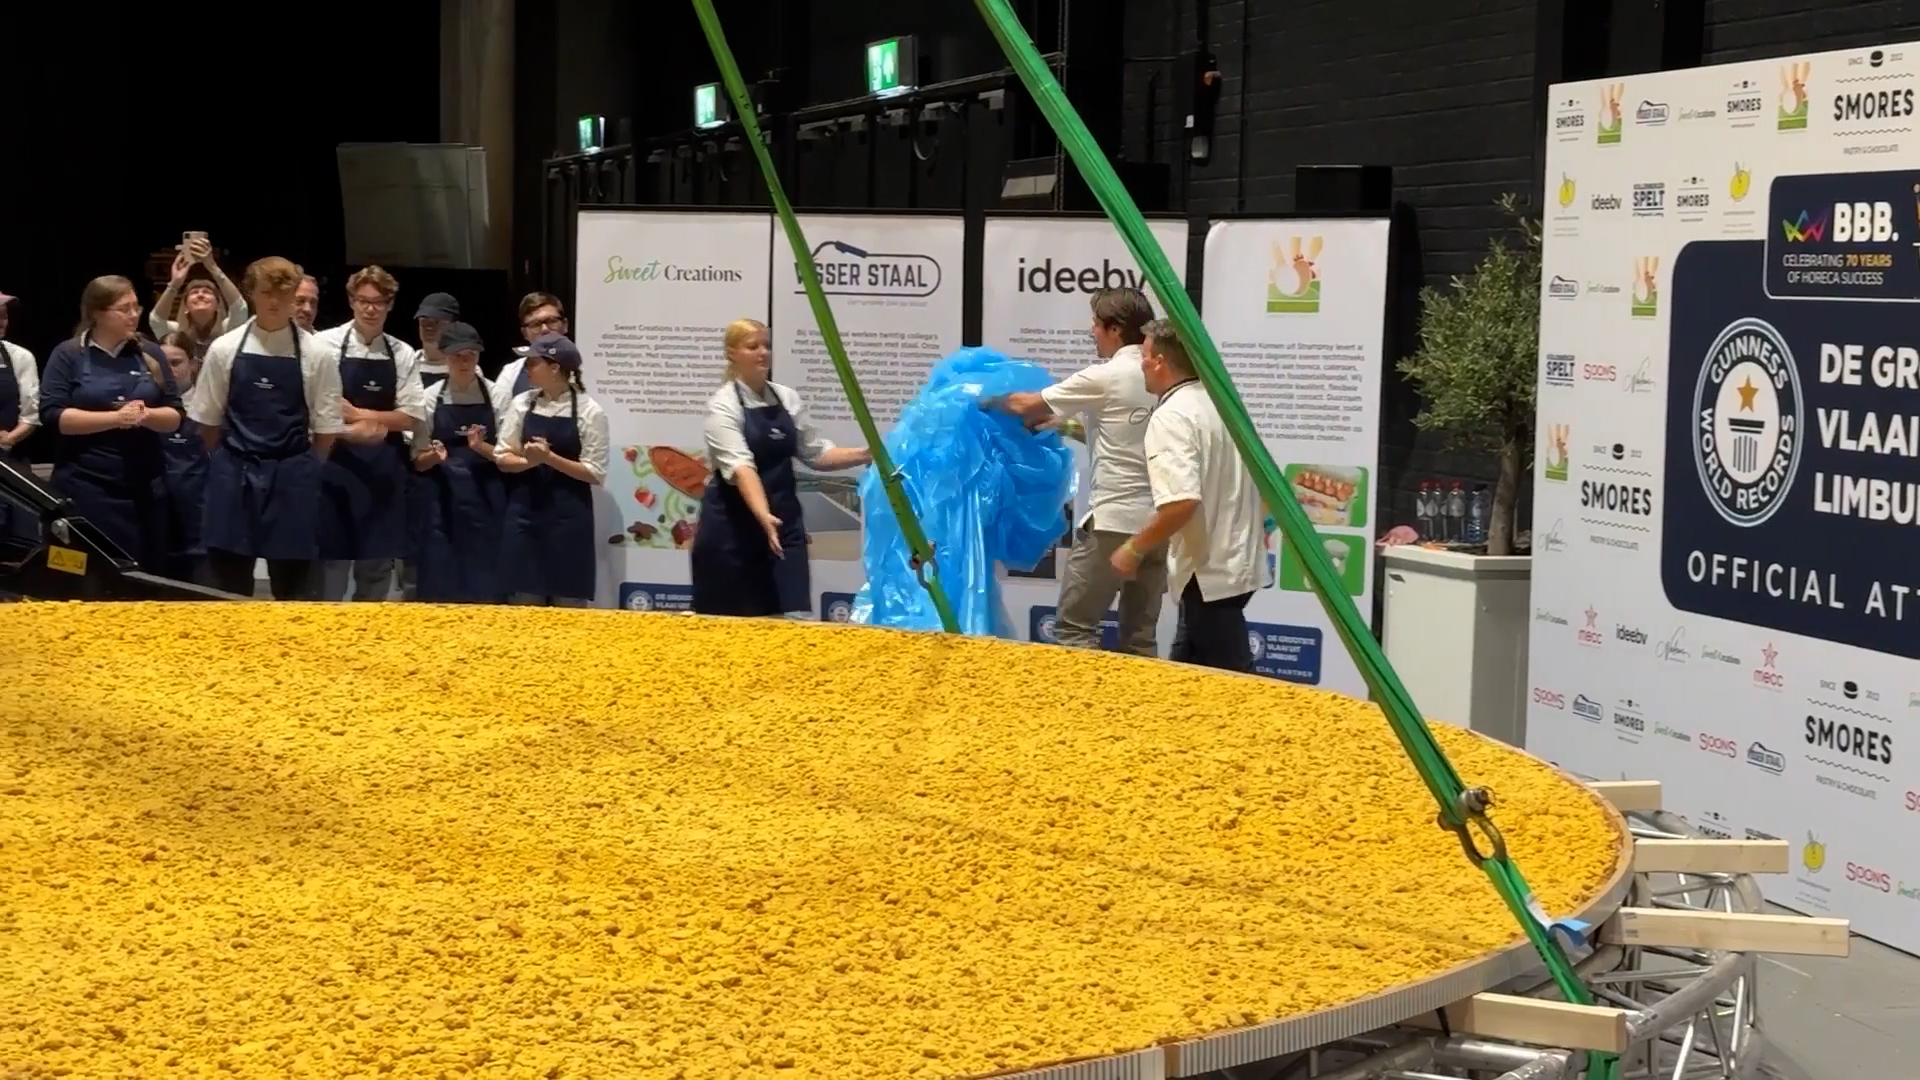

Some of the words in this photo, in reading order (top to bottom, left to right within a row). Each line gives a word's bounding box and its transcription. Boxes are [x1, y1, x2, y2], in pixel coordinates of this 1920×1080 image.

[1728, 98, 1762, 113] SMORES
[1834, 88, 1914, 121] SMORES
[1556, 114, 1584, 128] SMORES
[1633, 190, 1665, 207] SPELT
[1677, 194, 1710, 208] SMORES
[1832, 202, 1899, 242] BBB.
[603, 256, 662, 283] Sweet
[664, 264, 742, 282] Creations
[1782, 254, 1844, 267] CELEBRATING
[1846, 254, 1858, 267] 70
[1860, 254, 1892, 268] YEARS
[868, 264, 928, 288] STAAL
[1787, 271, 1801, 284] OF
[1802, 272, 1840, 284] HORECA
[1841, 272, 1884, 285] SUCCESS
[1546, 362, 1575, 377] SPELT
[1583, 364, 1616, 382] SOONS
[1710, 335, 1788, 390] GUINNESS
[1819, 343, 1864, 386] DE
[1871, 346, 1920, 390] GR
[1816, 408, 1919, 457] VLAAI
[1700, 407, 1732, 499] WORLD
[1736, 414, 1794, 510] RECORDS
[1581, 480, 1652, 516] SMORES
[1687, 550, 1844, 609] OFFICIAL
[1754, 670, 1784, 688] mecc
[1534, 688, 1564, 710] SOONS
[1614, 713, 1644, 732] SMORES
[1699, 733, 1737, 758] SOONS
[1805, 716, 1892, 764] SMORES
[1846, 862, 1890, 893] SOONS
